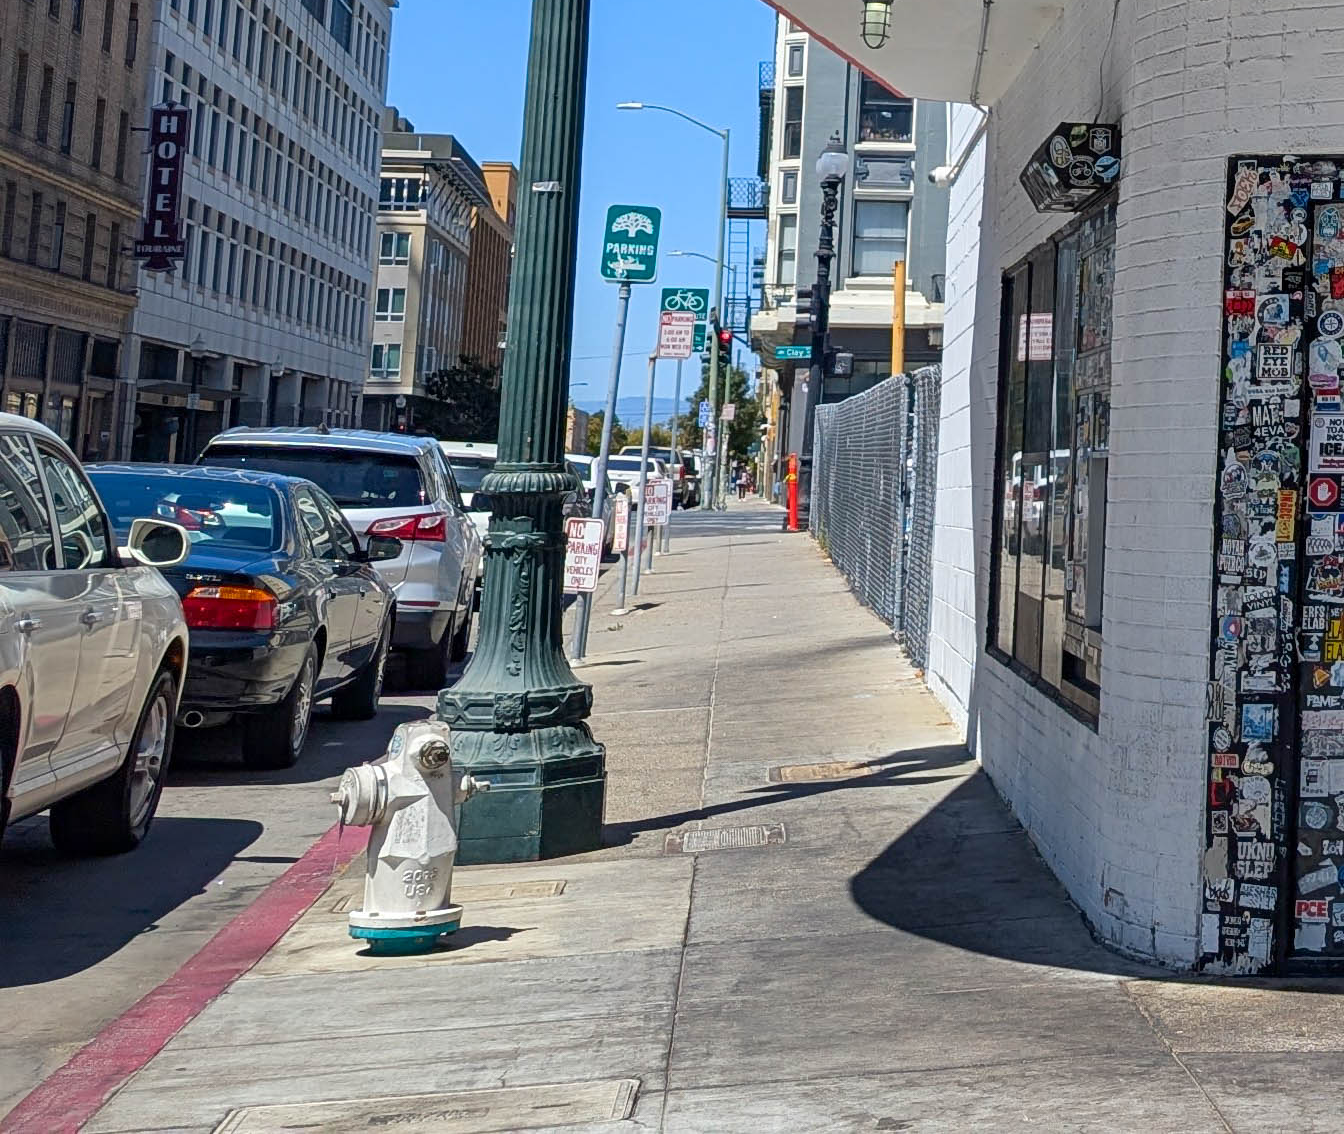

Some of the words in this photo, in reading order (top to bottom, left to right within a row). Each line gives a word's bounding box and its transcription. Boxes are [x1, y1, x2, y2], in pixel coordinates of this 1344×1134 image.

[153, 115, 179, 239] HOTEL
[606, 242, 655, 256] PARKING
[786, 348, 805, 357] Clay
[1262, 346, 1289, 355] RED
[1262, 356, 1289, 366] EYE
[1329, 418, 1342, 426] NO
[1326, 426, 1338, 434] TO
[569, 522, 584, 538] NO
[567, 540, 599, 555] PARKING
[574, 556, 587, 565] CITY
[566, 565, 594, 576] VEHICLES
[571, 576, 586, 585] ONLY
[1246, 599, 1276, 612] VINYL
